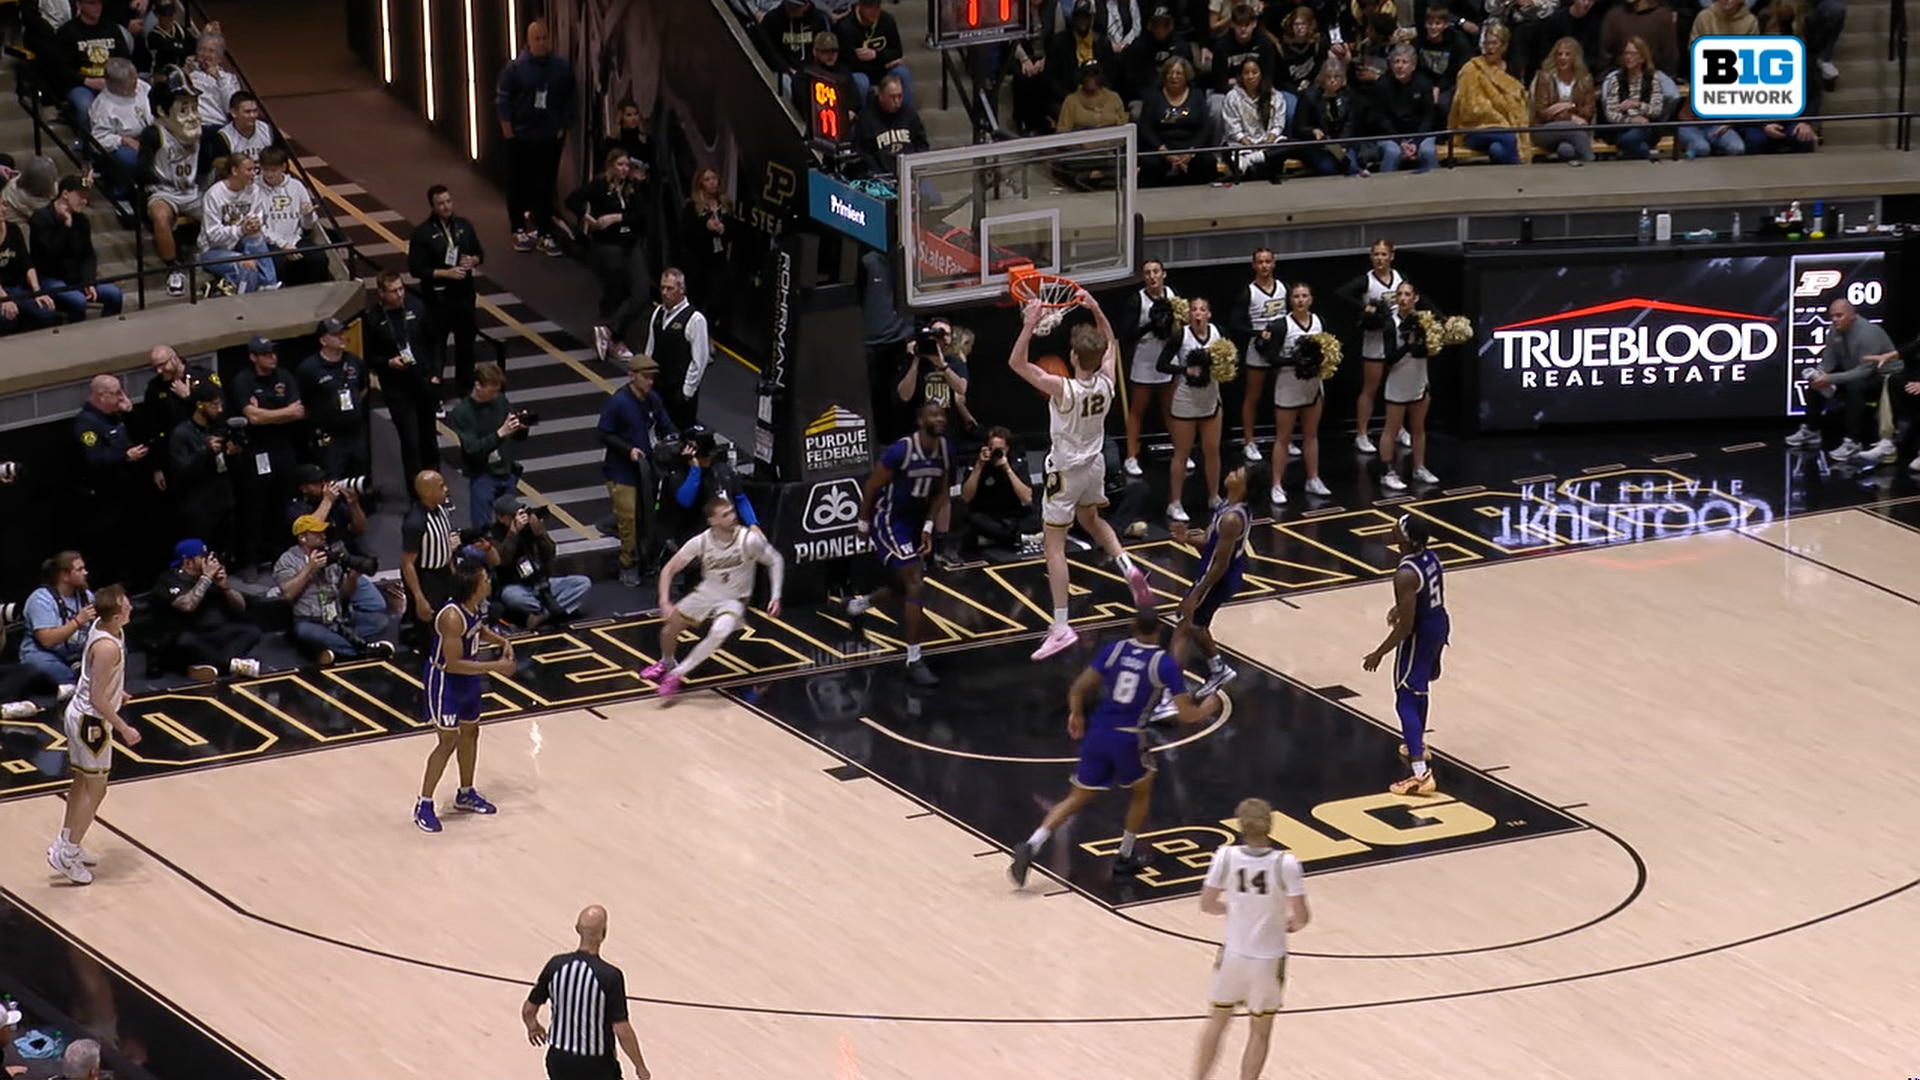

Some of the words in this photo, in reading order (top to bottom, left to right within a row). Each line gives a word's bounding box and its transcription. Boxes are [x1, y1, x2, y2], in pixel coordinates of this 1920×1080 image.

[830, 194, 865, 226] Primient
[1847, 281, 1882, 305] 60
[776, 251, 790, 387] ROHRMAN
[1493, 322, 1778, 369] TRUEBLOOD
[1522, 367, 1604, 388] REAL
[1620, 364, 1747, 386] ESTATE
[1081, 394, 1105, 417] 12
[805, 429, 867, 450] PURDUE
[806, 443, 868, 463] FEDERAL
[911, 478, 932, 497] 11
[900, 542, 914, 554] W
[1429, 575, 1442, 608] 5
[1112, 671, 1140, 704] 8
[442, 714, 457, 726] W
[1235, 867, 1269, 896] 14
